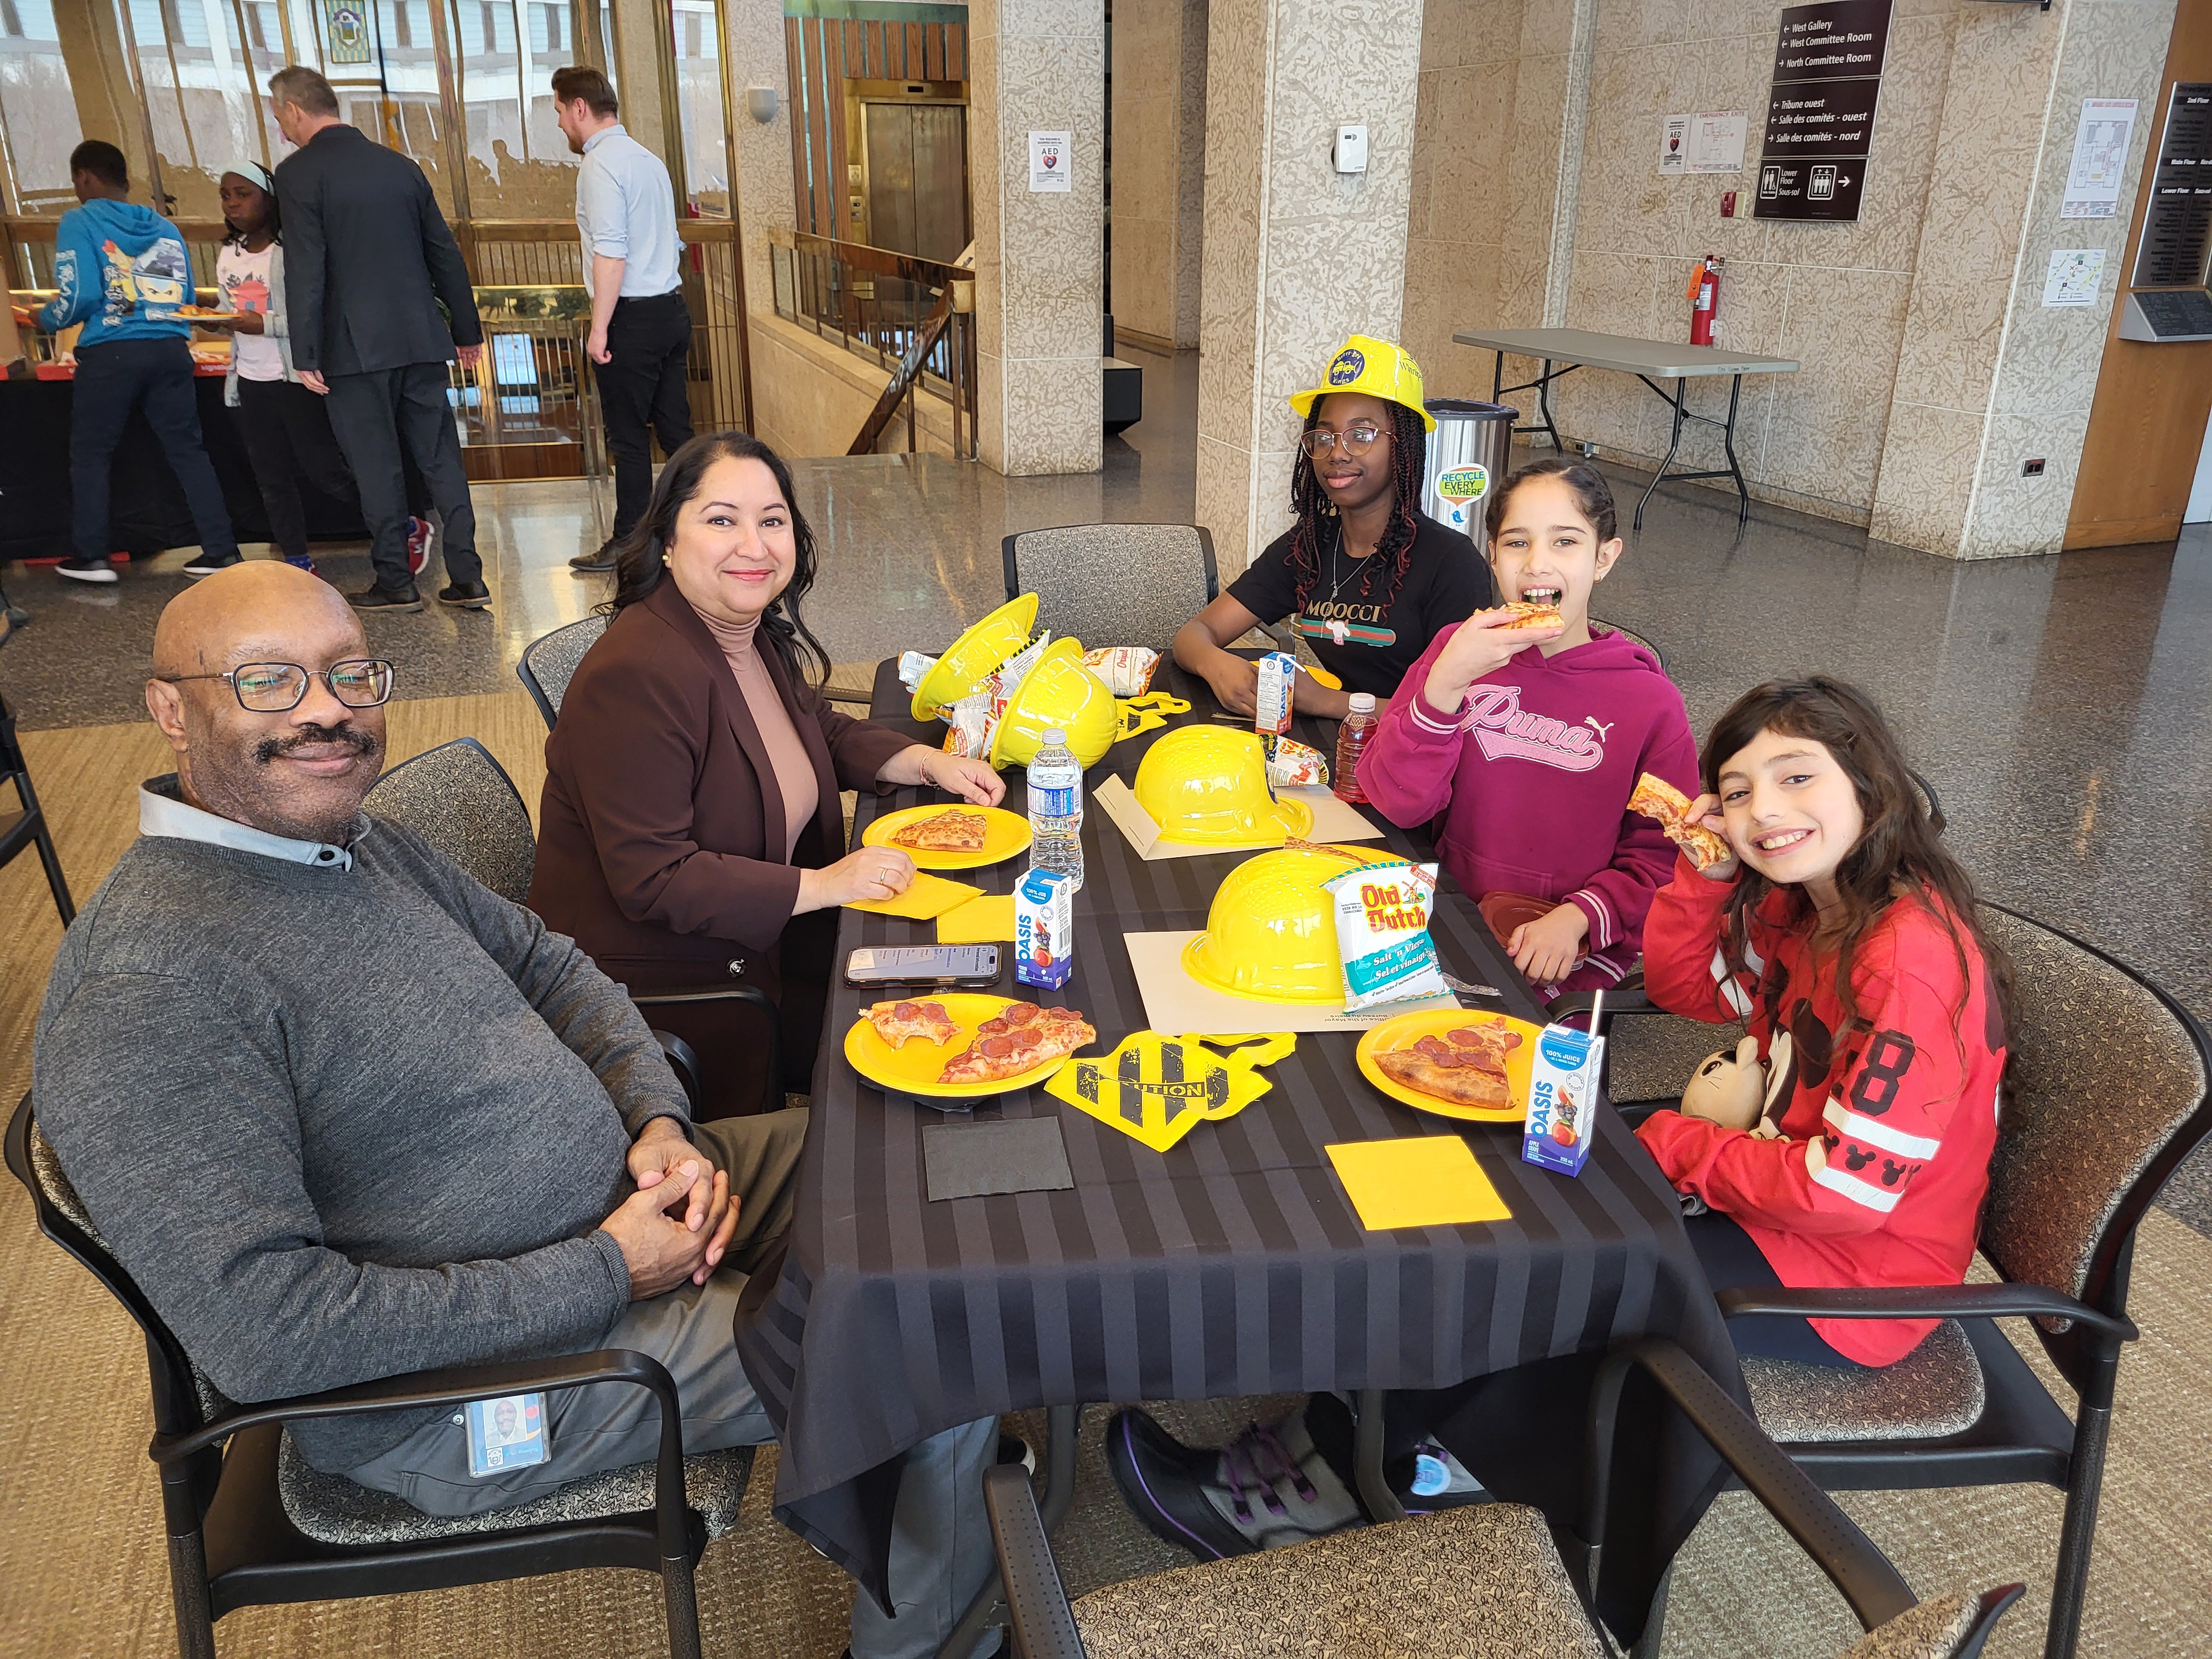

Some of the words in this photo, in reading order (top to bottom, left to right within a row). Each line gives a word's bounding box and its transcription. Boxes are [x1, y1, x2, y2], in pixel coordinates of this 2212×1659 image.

[1792, 23, 1807, 33] West
[1808, 20, 1833, 32] Gallery
[1790, 39, 1804, 48] West
[1806, 34, 1845, 46] Committee
[1847, 33, 1872, 43] Room
[1786, 59, 1803, 69] North
[1804, 55, 1844, 66] Committee
[1846, 54, 1871, 64] Room
[1781, 100, 1803, 110] Tribune
[1804, 98, 1825, 108] ouest
[1778, 116, 1793, 125] Salle
[1794, 114, 1805, 123] des
[1806, 113, 1835, 123] comités
[1842, 112, 1867, 121] ouest
[1776, 134, 1790, 143] Salle
[1791, 133, 1802, 142] des
[1803, 132, 1832, 142] comités
[1839, 131, 1861, 142] nord
[1778, 188, 1800, 196] Sous-sol
[1442, 471, 1485, 482] RECYCLE
[1445, 481, 1476, 489] EVERY
[1305, 599, 1381, 622] MOOCCI
[1459, 684, 1595, 755] Puma
[1361, 884, 1401, 908] Old
[1366, 906, 1426, 933] Dutch
[1018, 915, 1031, 963] OASIS
[1373, 953, 1393, 966] Salt
[1375, 966, 1389, 980] Sel
[1390, 964, 1399, 973] et
[1545, 1049, 1562, 1058] 100%
[1562, 1053, 1580, 1063] JUICE
[1531, 1081, 1553, 1138] OASIS
